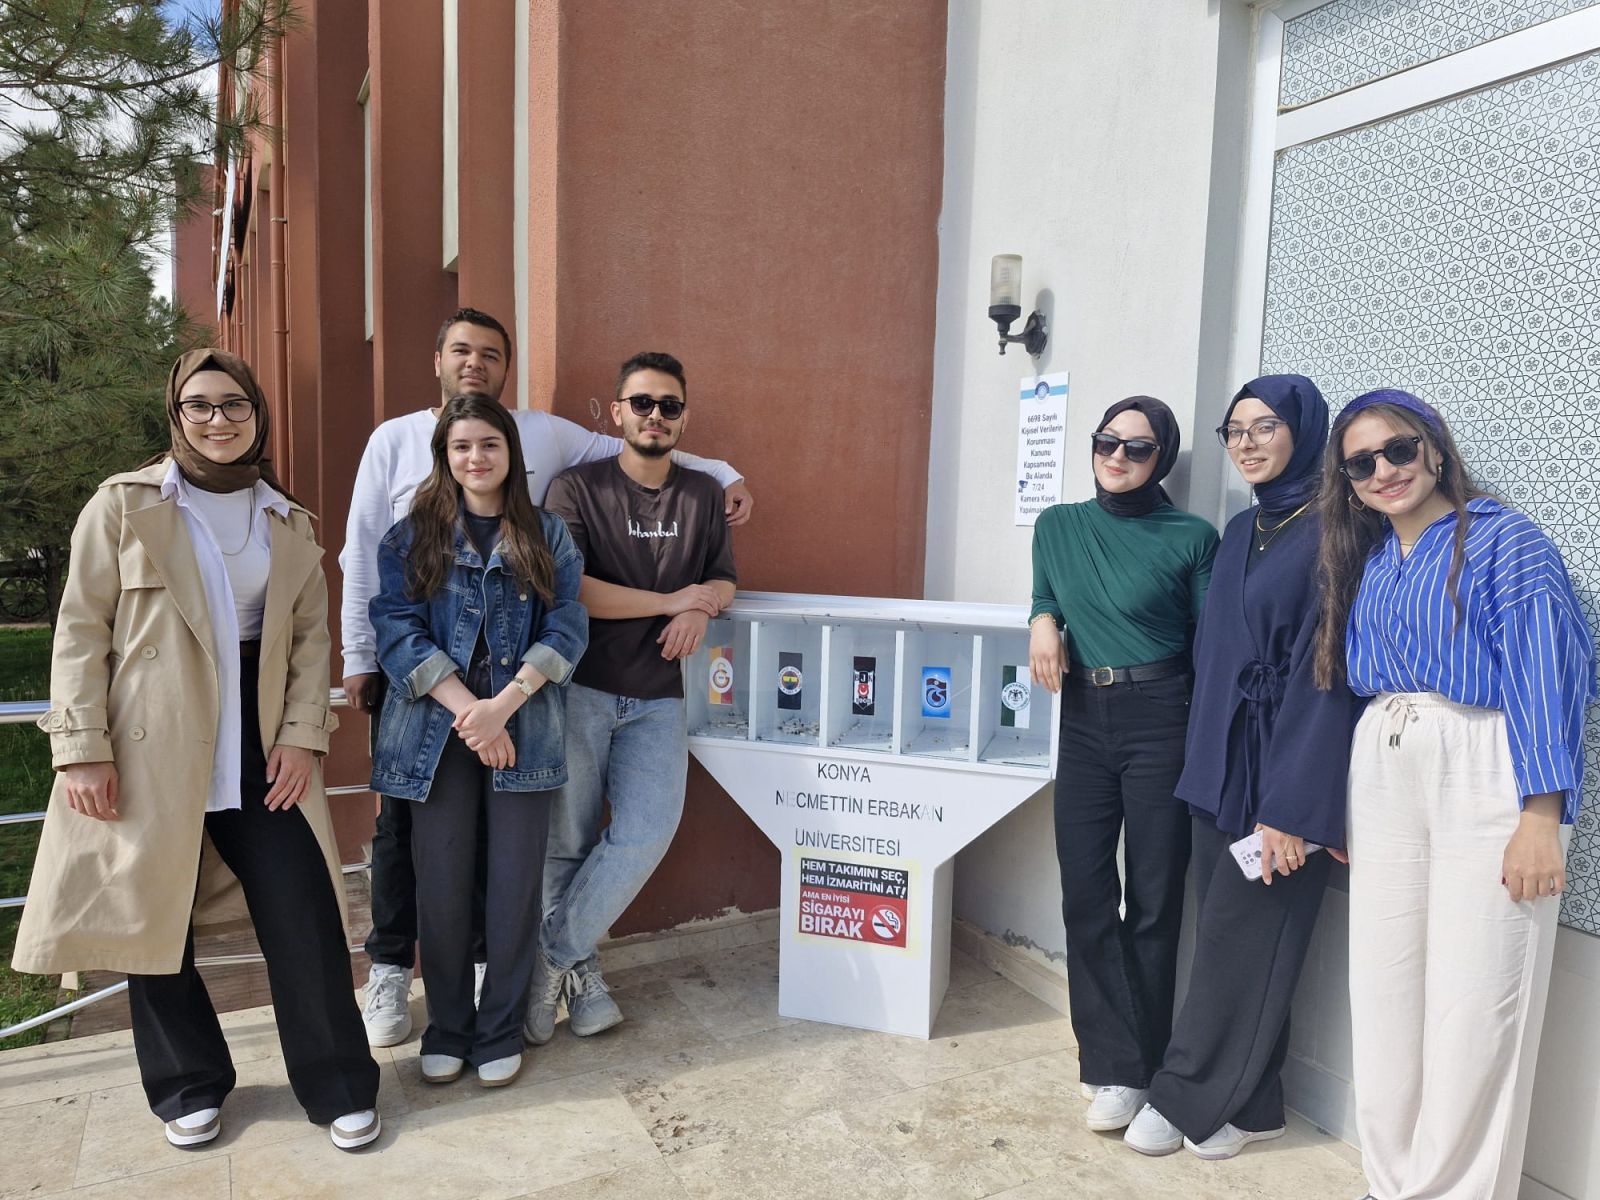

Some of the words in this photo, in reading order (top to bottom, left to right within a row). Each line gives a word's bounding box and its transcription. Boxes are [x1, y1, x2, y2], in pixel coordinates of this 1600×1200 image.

[1028, 414, 1041, 423] 6698
[1040, 424, 1064, 433] Verilerin
[1030, 449, 1051, 457] Kanunu
[1034, 471, 1053, 479] Alanda
[1032, 482, 1045, 491] 7/24
[1020, 495, 1040, 503] Kamera
[817, 763, 871, 783] KONYA
[868, 799, 943, 822] ERBAKAN
[802, 860, 826, 872] HEM
[828, 862, 879, 879] TAKIMINI
[801, 873, 825, 885] HEM
[886, 885, 906, 899] AT!
[802, 890, 820, 899] AMA
[801, 899, 865, 921] SİGARAYI
[801, 914, 864, 939] BIRAK
